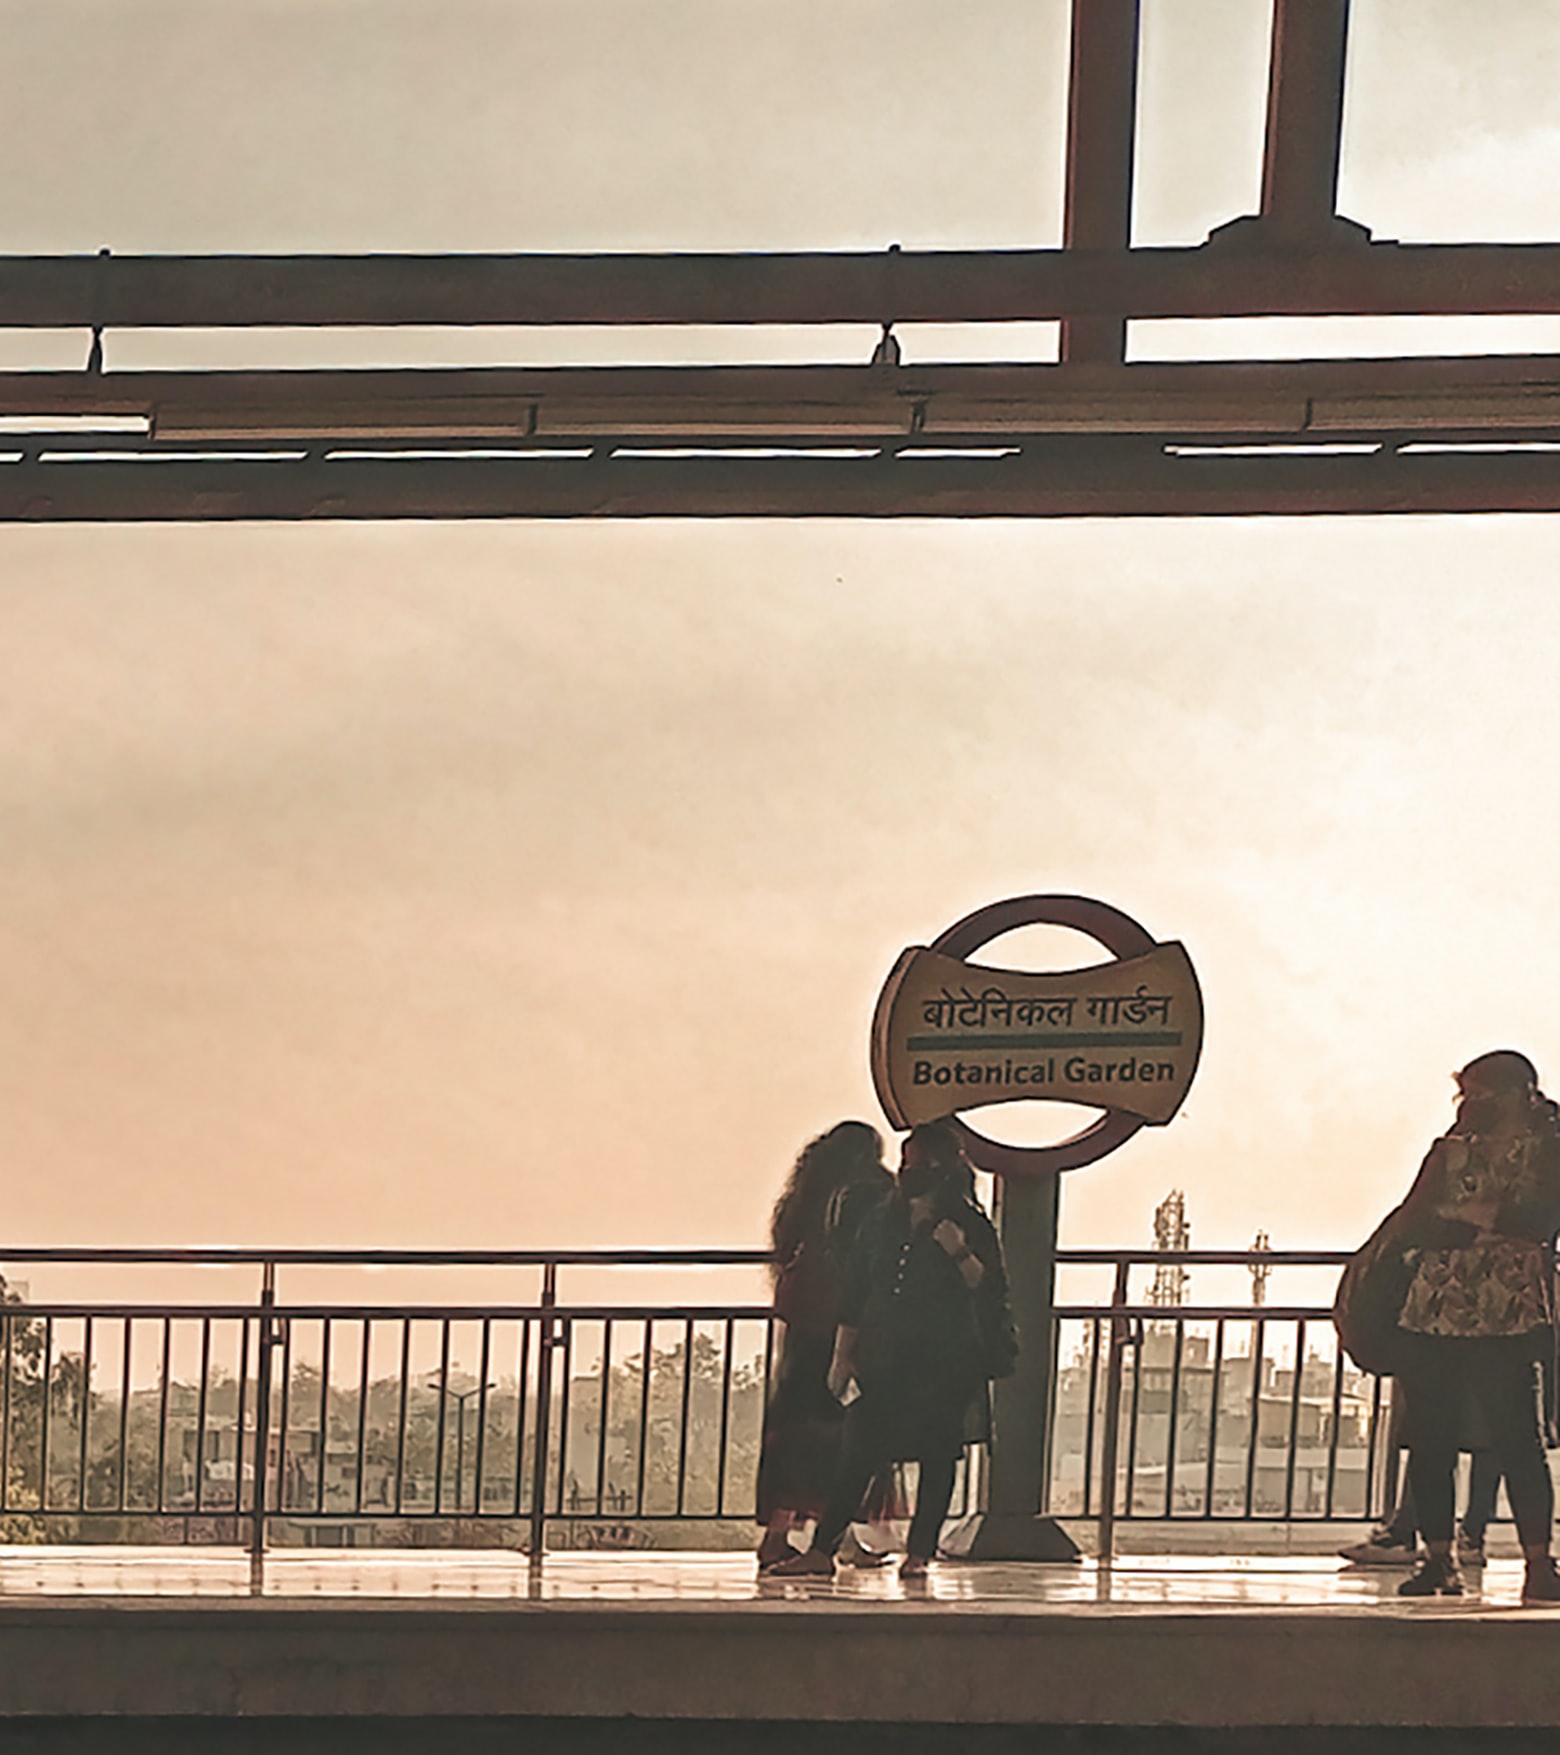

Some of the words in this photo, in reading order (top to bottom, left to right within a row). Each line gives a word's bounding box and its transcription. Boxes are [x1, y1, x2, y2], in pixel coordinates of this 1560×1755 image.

[1086, 984, 1174, 1026] गार्डन
[912, 1057, 1055, 1085] Botanical
[1063, 1056, 1175, 1084] Garden
